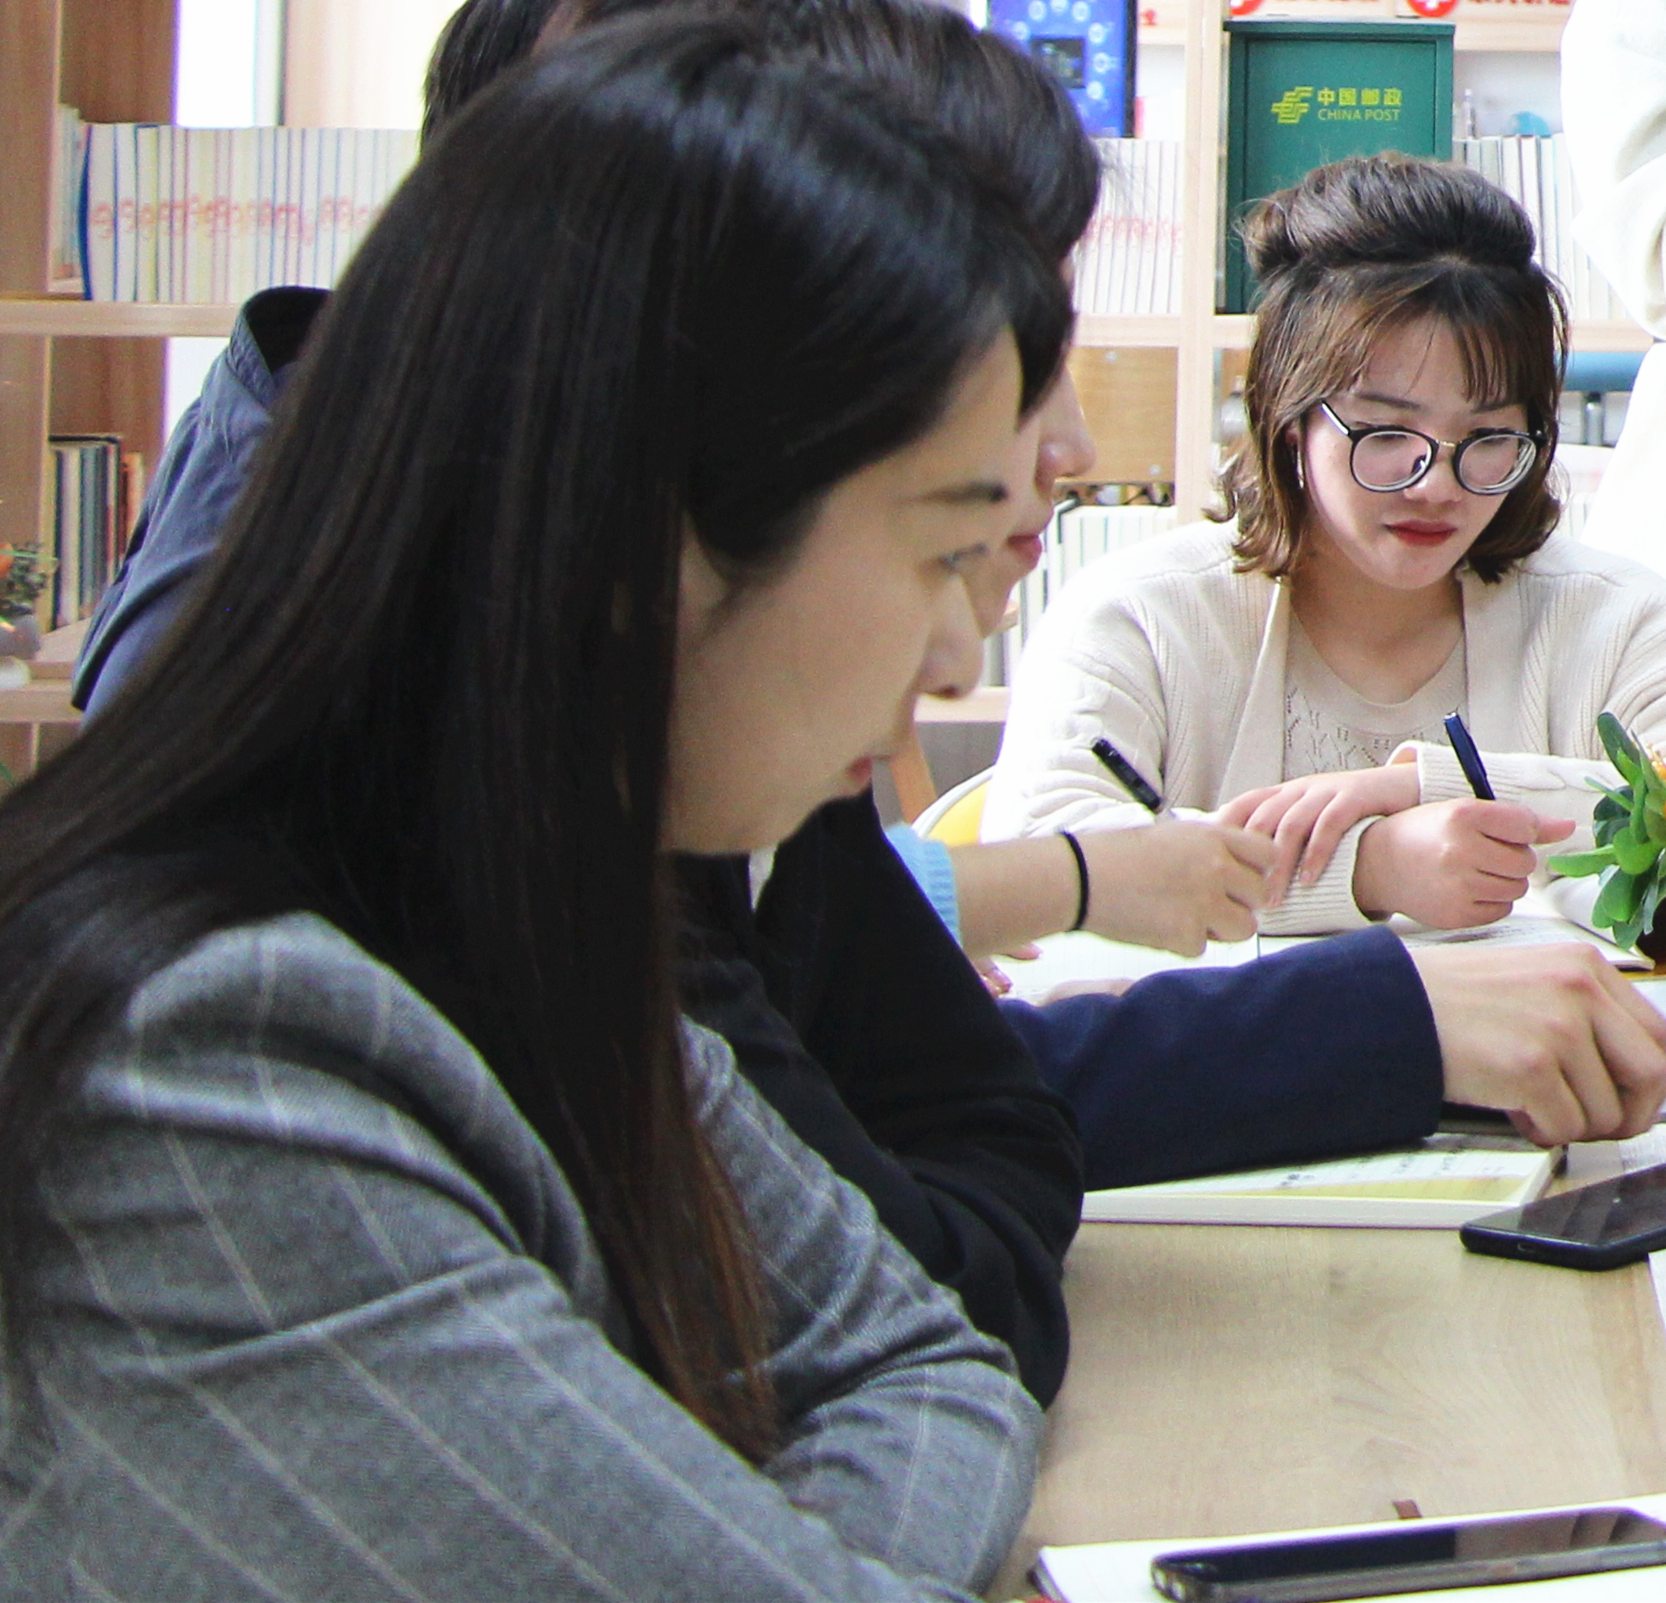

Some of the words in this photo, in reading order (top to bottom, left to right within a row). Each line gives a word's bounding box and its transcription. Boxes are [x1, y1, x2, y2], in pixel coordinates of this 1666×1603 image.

[1317, 87, 1402, 107] 中国邮政
[1317, 108, 1361, 121] CHINA
[1364, 109, 1401, 122] POST
